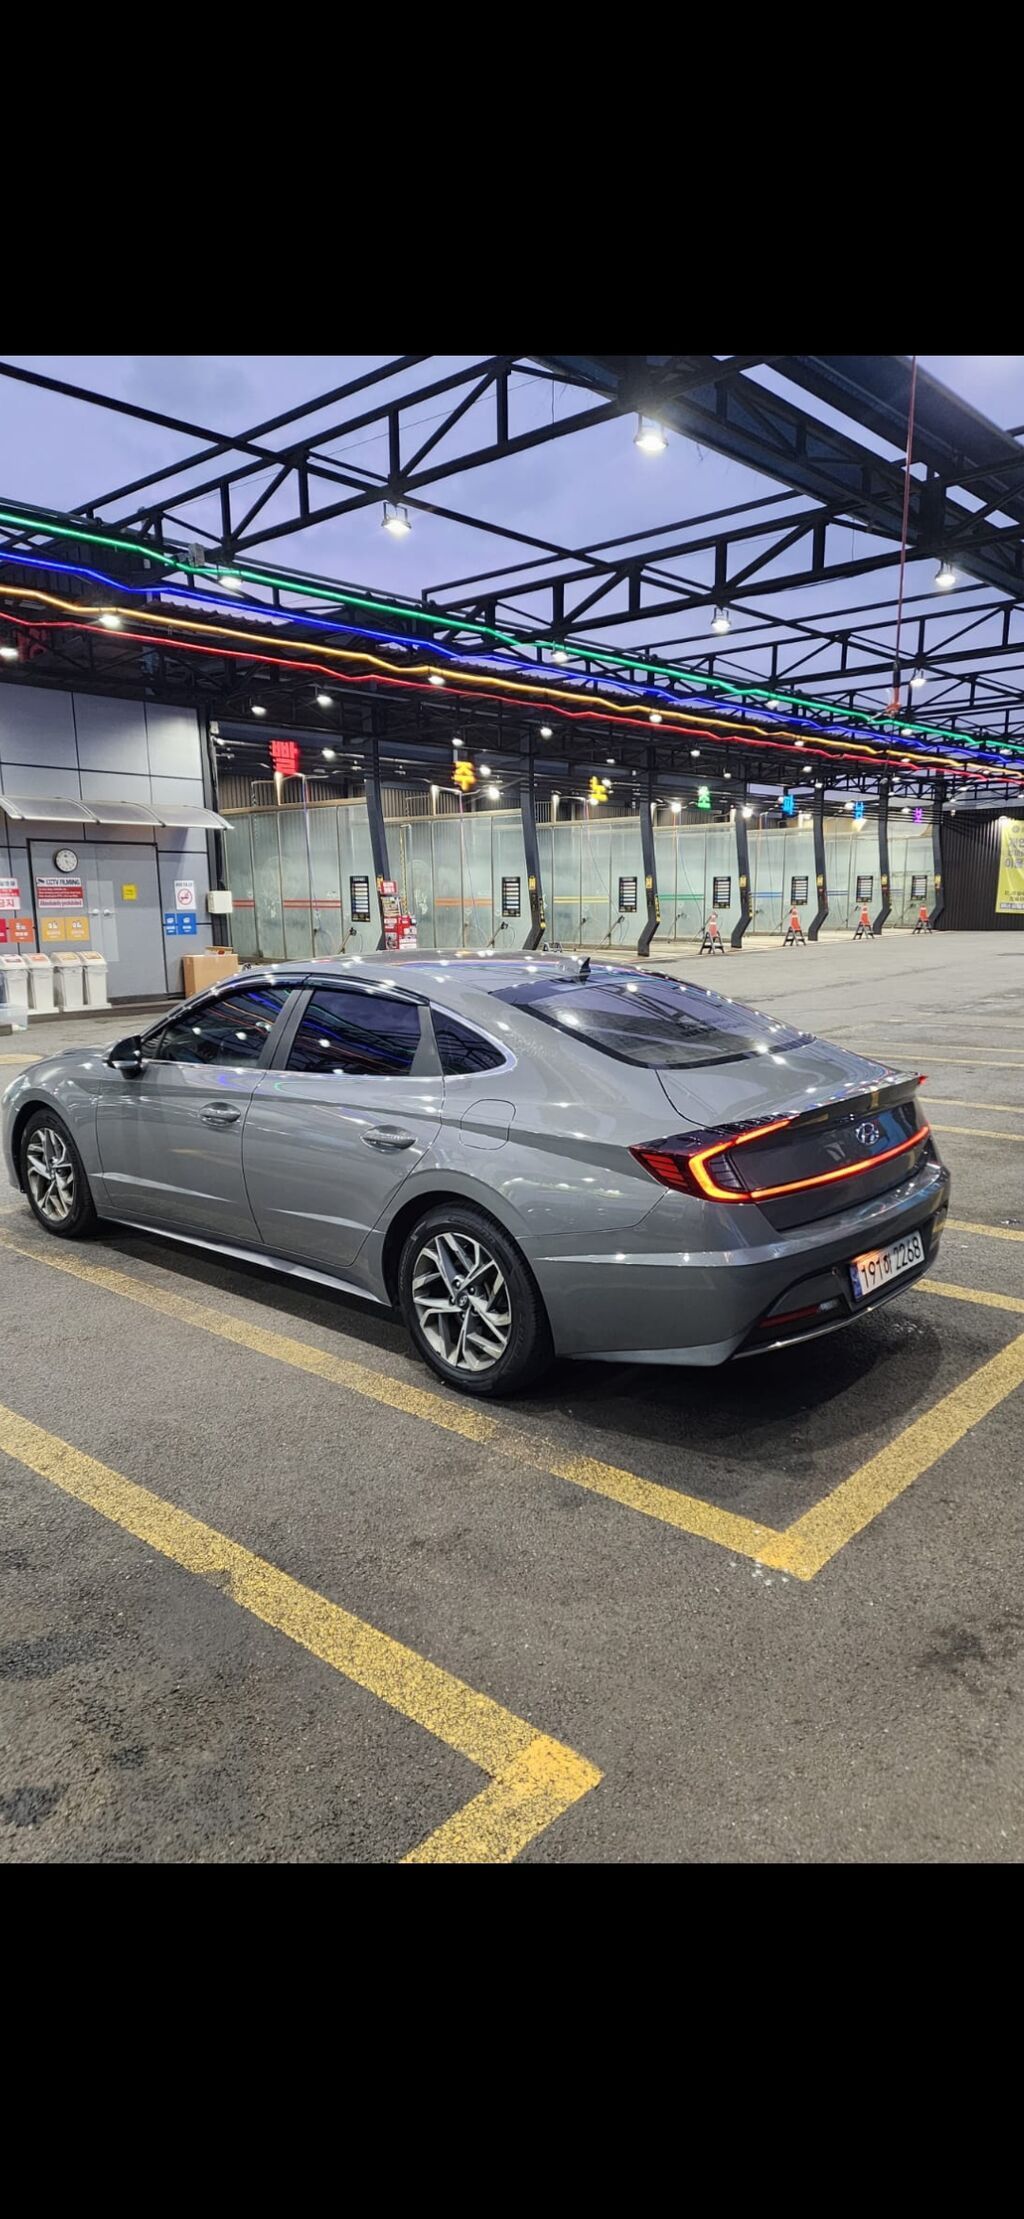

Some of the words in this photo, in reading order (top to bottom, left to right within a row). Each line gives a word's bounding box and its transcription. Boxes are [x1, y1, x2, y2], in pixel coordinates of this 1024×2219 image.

[270, 740, 299, 775] 빨
[453, 761, 476, 791] 주
[590, 776, 607, 801] 노
[893, 1236, 921, 1270] 2268
